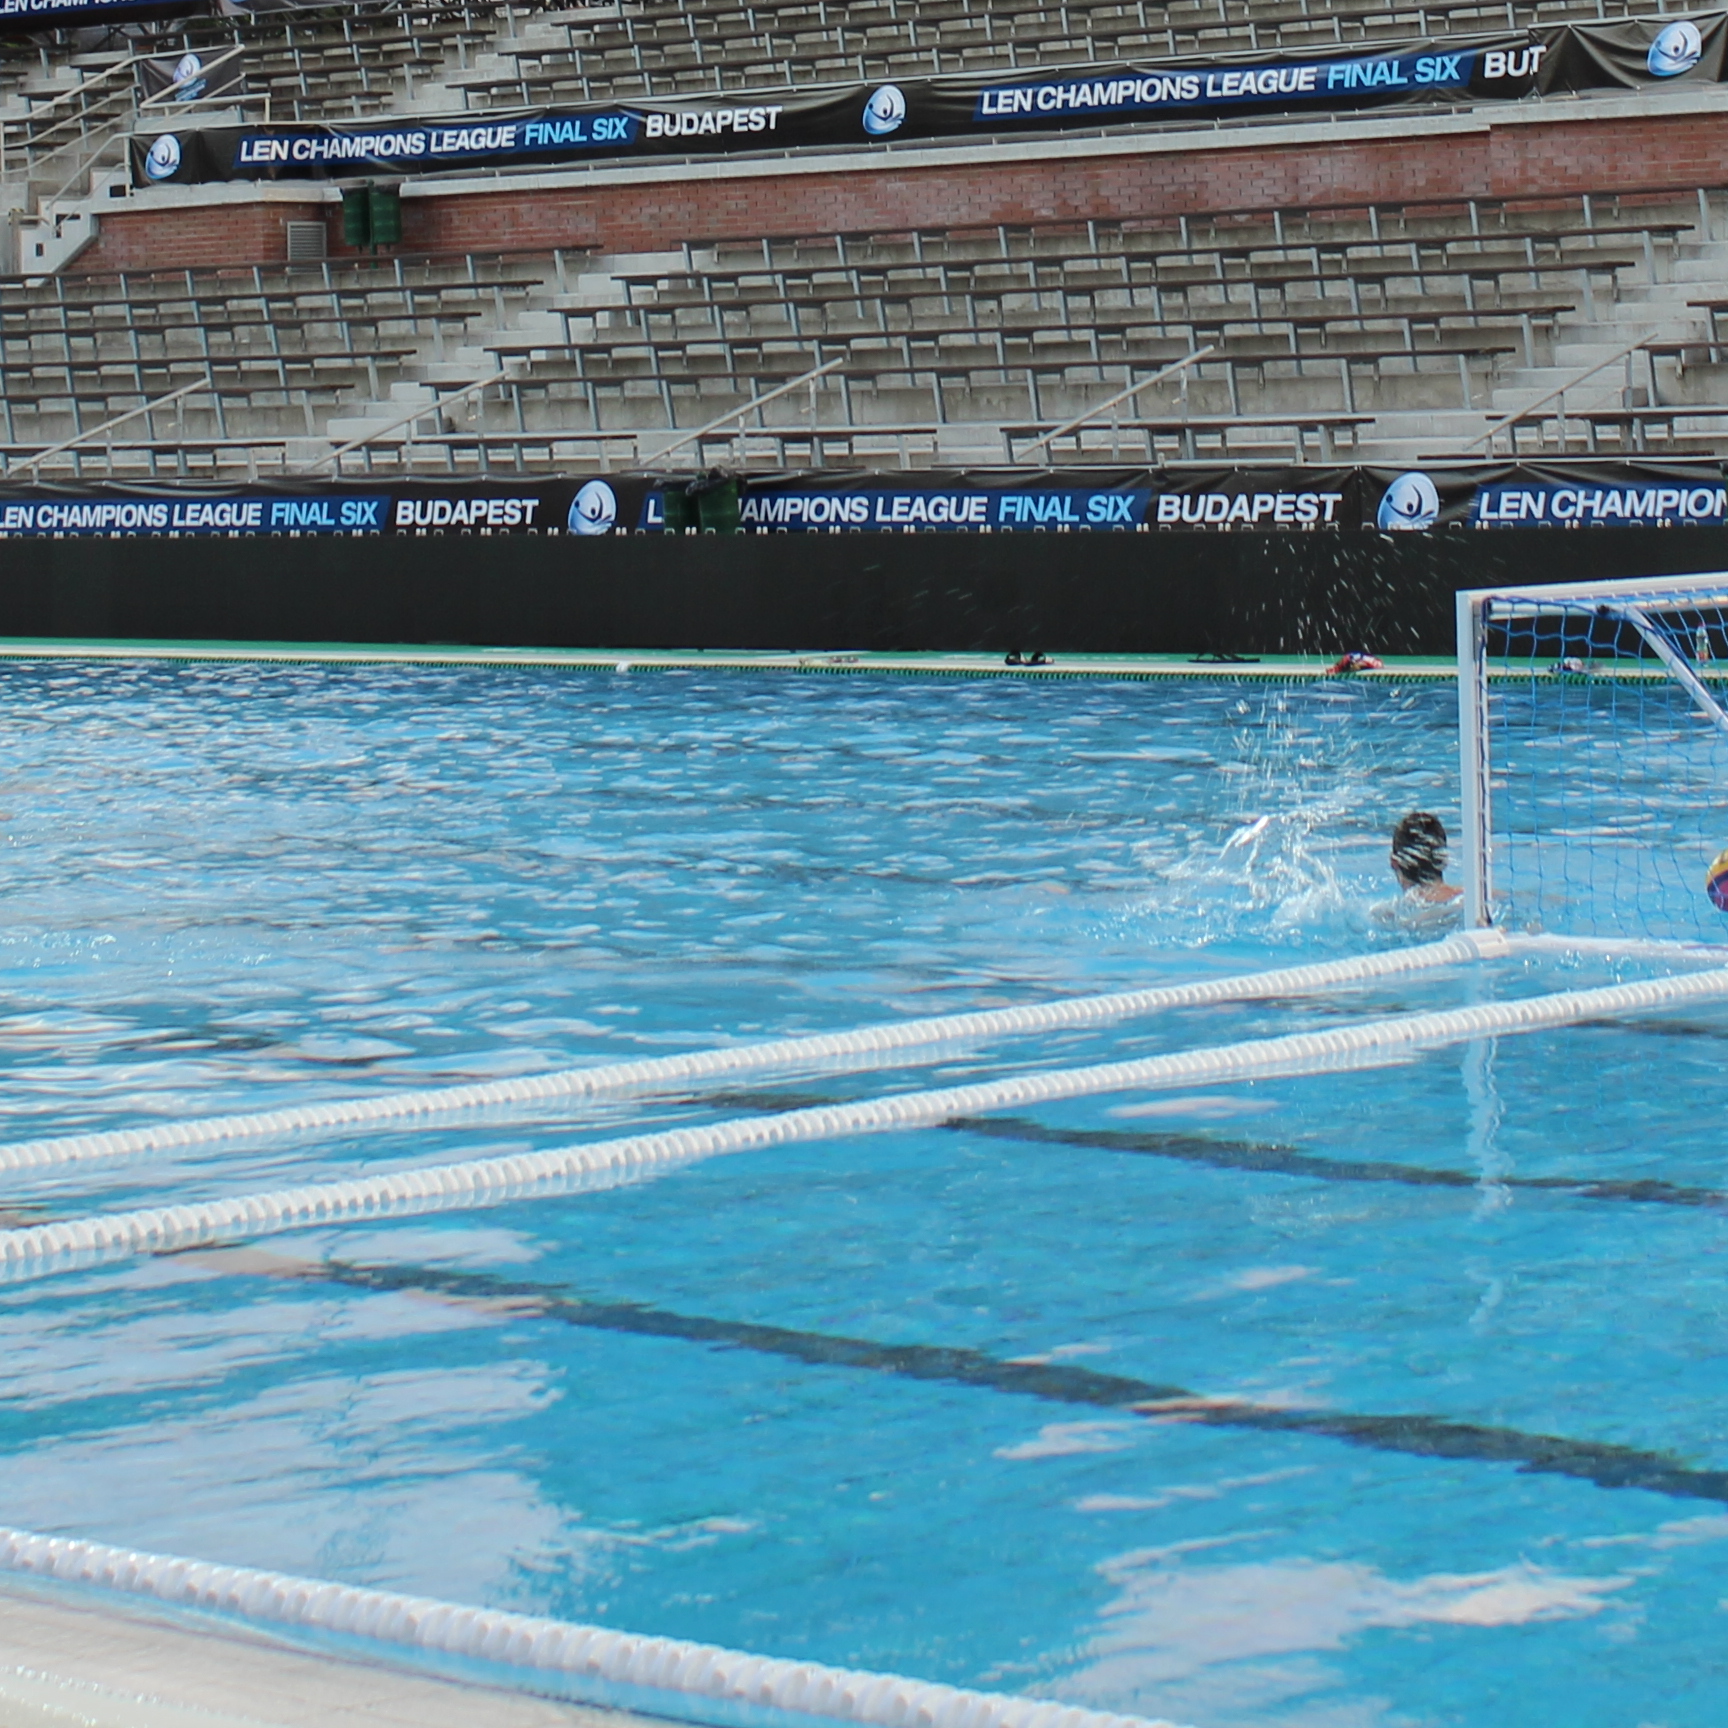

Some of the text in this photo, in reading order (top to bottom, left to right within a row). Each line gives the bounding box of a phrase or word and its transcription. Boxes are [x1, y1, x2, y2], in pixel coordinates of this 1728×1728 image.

[981, 87, 1035, 115] LEN
[1036, 74, 1201, 111] CHAMPIONS
[1205, 65, 1316, 100] LEAGUE
[1326, 60, 1409, 91] FINAL
[1414, 54, 1462, 82] SIX
[239, 105, 783, 163] LEN CHAMPIONS LEAGUE FINAL SIX BUDAPEST
[36, 503, 168, 528] CHAMPIONS
[172, 502, 262, 527] LEAGUE
[270, 501, 335, 526] FINAL
[339, 500, 378, 526] SIX
[395, 498, 539, 526] BUDAPEST
[738, 493, 1343, 524] AMPIONS LEAGUE FINAL SIX BUDAPEST
[1479, 490, 1547, 521] LEN
[1551, 488, 1727, 519] CHAMPION
